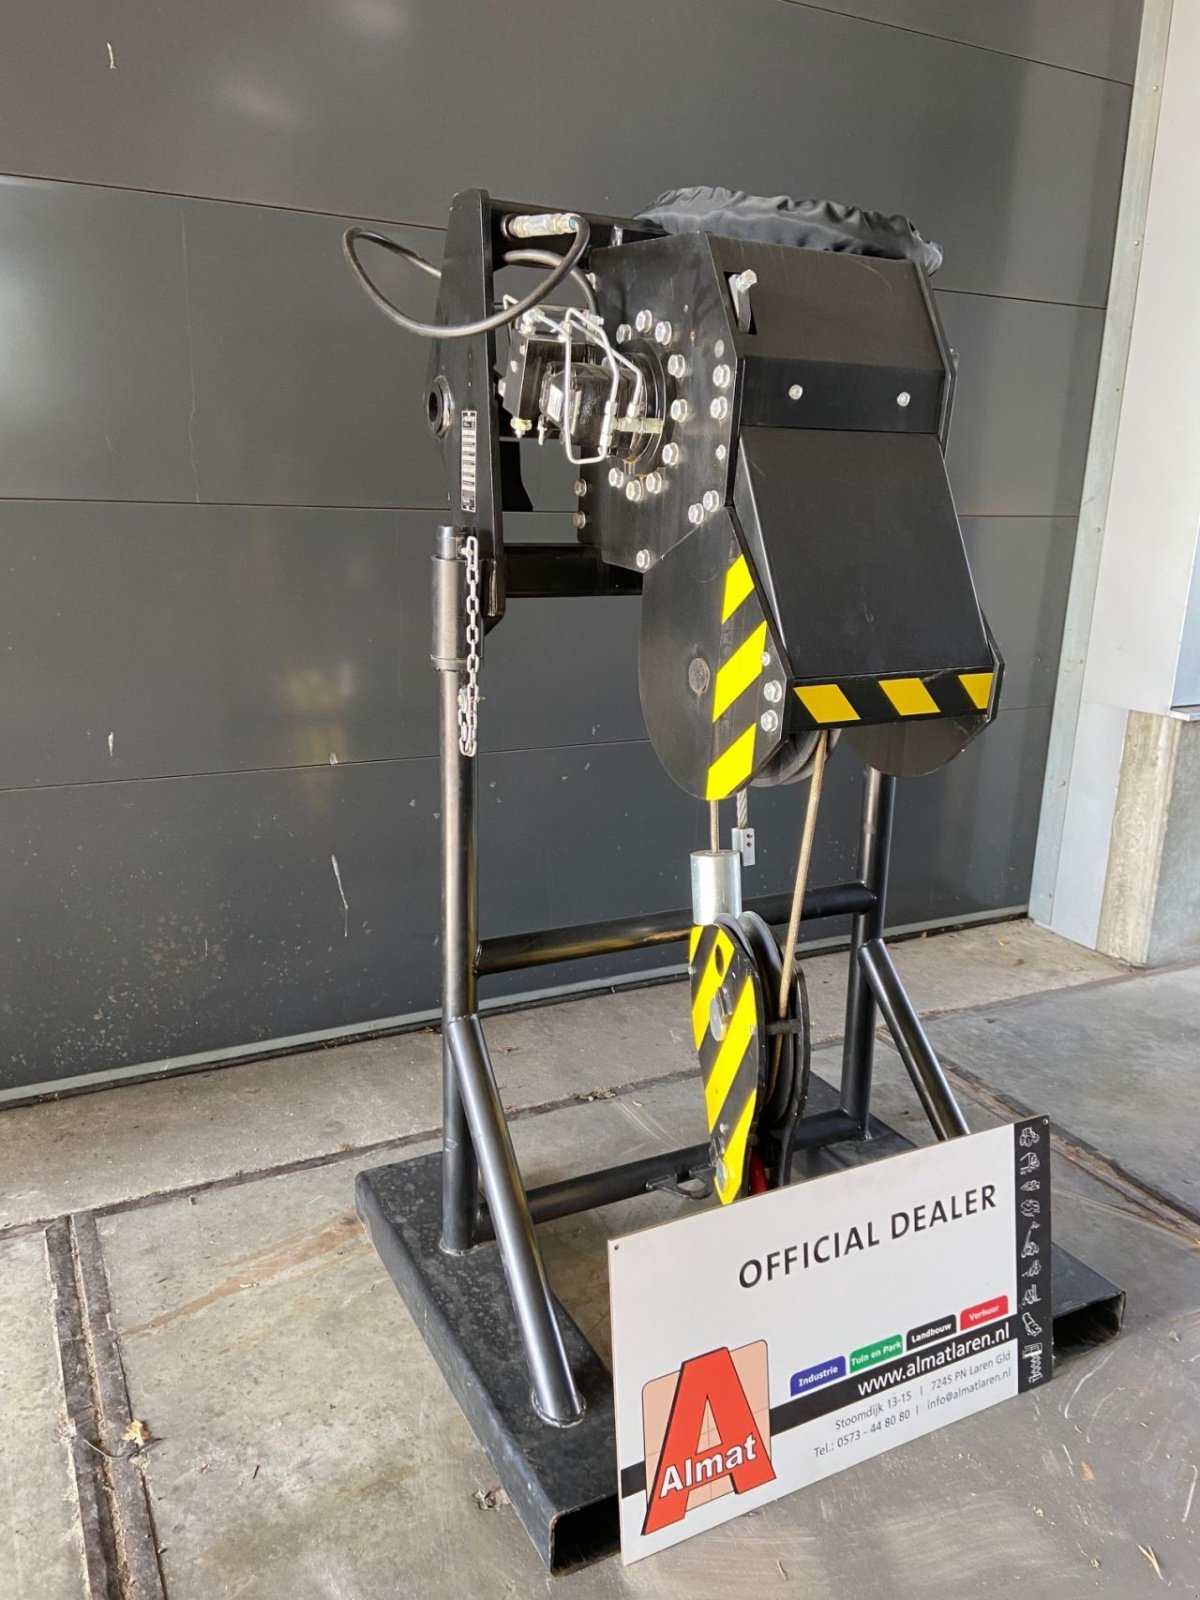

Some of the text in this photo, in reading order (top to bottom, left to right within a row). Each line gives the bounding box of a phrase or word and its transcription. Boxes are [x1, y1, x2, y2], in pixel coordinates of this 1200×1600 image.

[739, 1184, 997, 1289] OFFICIAL DEALER
[911, 1322, 952, 1344] Landbouw
[968, 1304, 1000, 1322] Verhuur
[798, 1365, 839, 1387] Industrie
[851, 1342, 902, 1367] Tuin en Park
[857, 1322, 1010, 1397] www.almatlaren.nl
[813, 1443, 834, 1457] Tel.:
[837, 1430, 861, 1449] 0573
[870, 1420, 882, 1434] 44
[884, 1414, 897, 1428] 80
[898, 1408, 911, 1422] 80
[927, 1367, 1012, 1411] info@almatlaren.nl
[835, 1351, 1011, 1431] Stoomdijk 13-15 7245 PN Laren Gld
[659, 1432, 757, 1499] Almat
